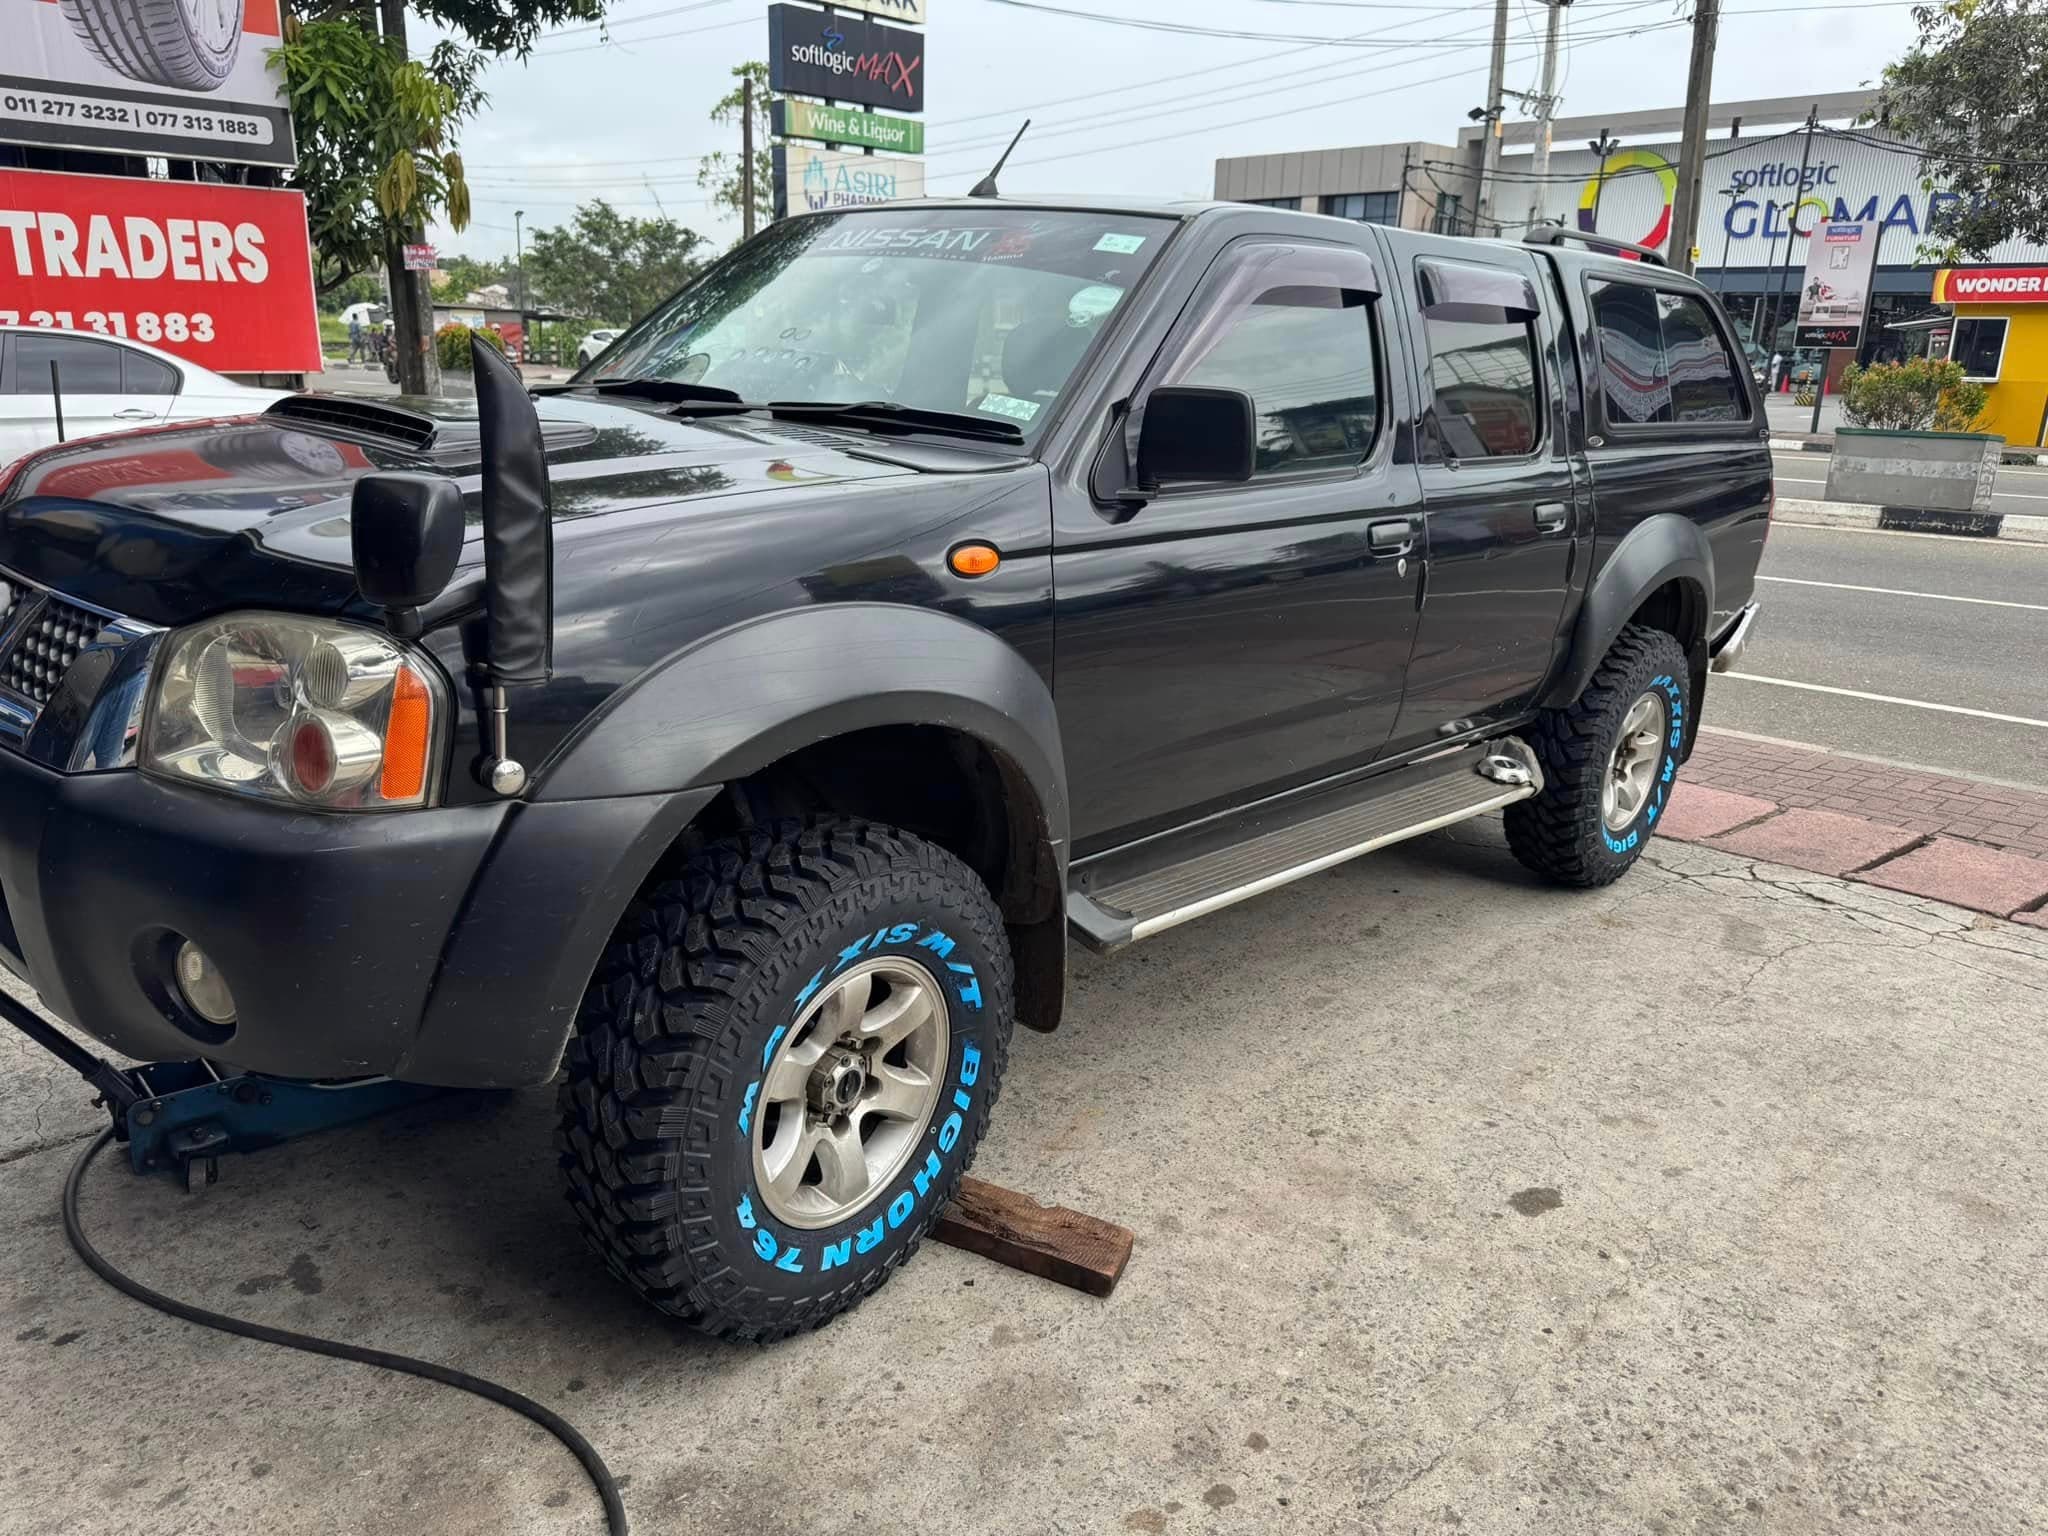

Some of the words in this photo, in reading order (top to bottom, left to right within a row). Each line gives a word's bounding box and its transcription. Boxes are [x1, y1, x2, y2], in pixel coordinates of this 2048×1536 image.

[792, 44, 854, 74] softlogic
[853, 51, 920, 97] MAX
[5, 95, 37, 114] 011
[42, 99, 75, 118] 277
[81, 104, 129, 123] 3232
[146, 111, 177, 129] 077
[183, 115, 214, 132] 313
[217, 119, 258, 136] 1883
[807, 110, 845, 134] Wine
[847, 118, 860, 135] &
[863, 120, 906, 144] Liquor
[833, 164, 896, 198] ASIRI
[1730, 160, 1840, 193] softlogic
[0, 210, 269, 284] TRADERS
[828, 228, 991, 251] NISSAN
[1956, 277, 2041, 293] WONDER
[135, 312, 215, 342] 883
[917, 934, 983, 1009] M/T
[820, 1046, 981, 1272] BIGHORN
